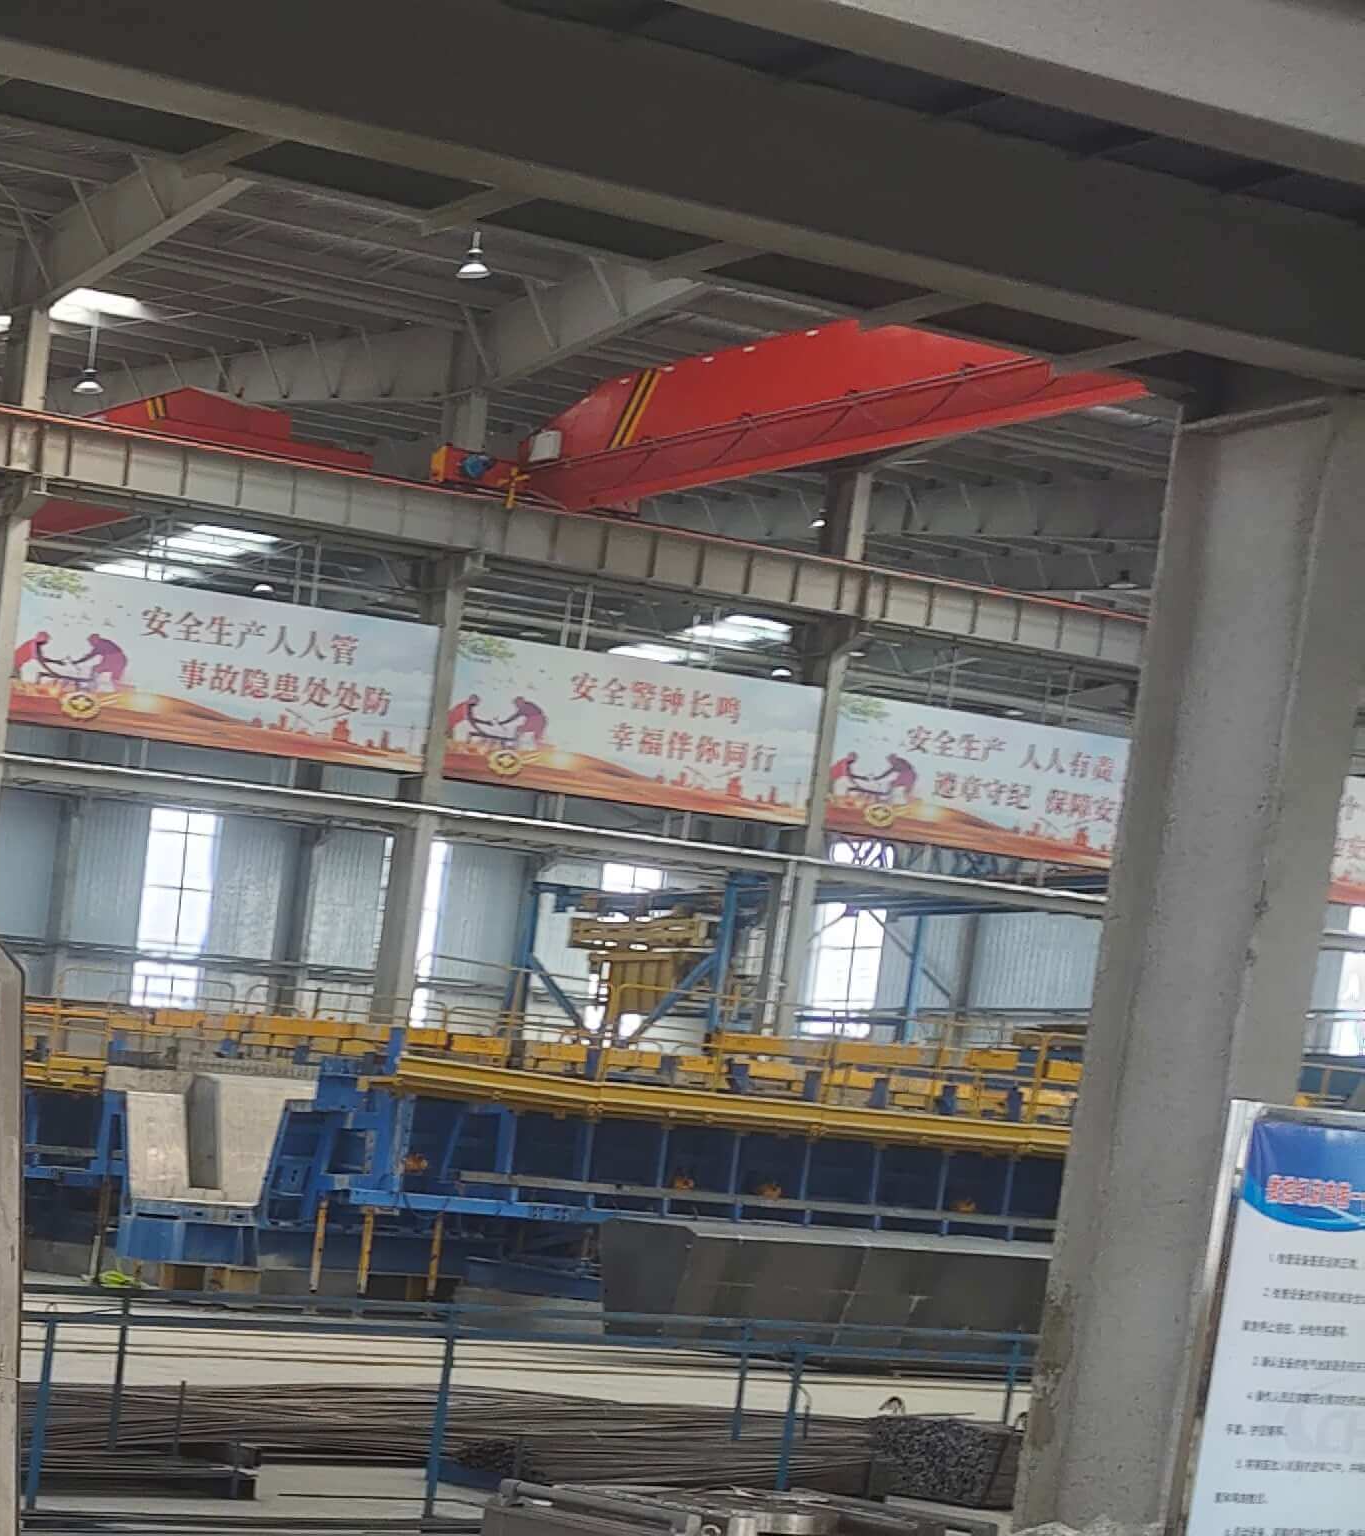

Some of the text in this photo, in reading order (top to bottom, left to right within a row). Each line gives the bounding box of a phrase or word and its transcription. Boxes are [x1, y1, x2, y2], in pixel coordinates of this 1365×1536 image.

[140, 606, 359, 666] 安全生产人人管
[178, 659, 391, 718] 事故隐患处处防
[571, 671, 742, 724] 安全警钟长鸣
[609, 722, 778, 772] 幸福伴你同行
[906, 726, 1115, 782] 安全生产 人人有责
